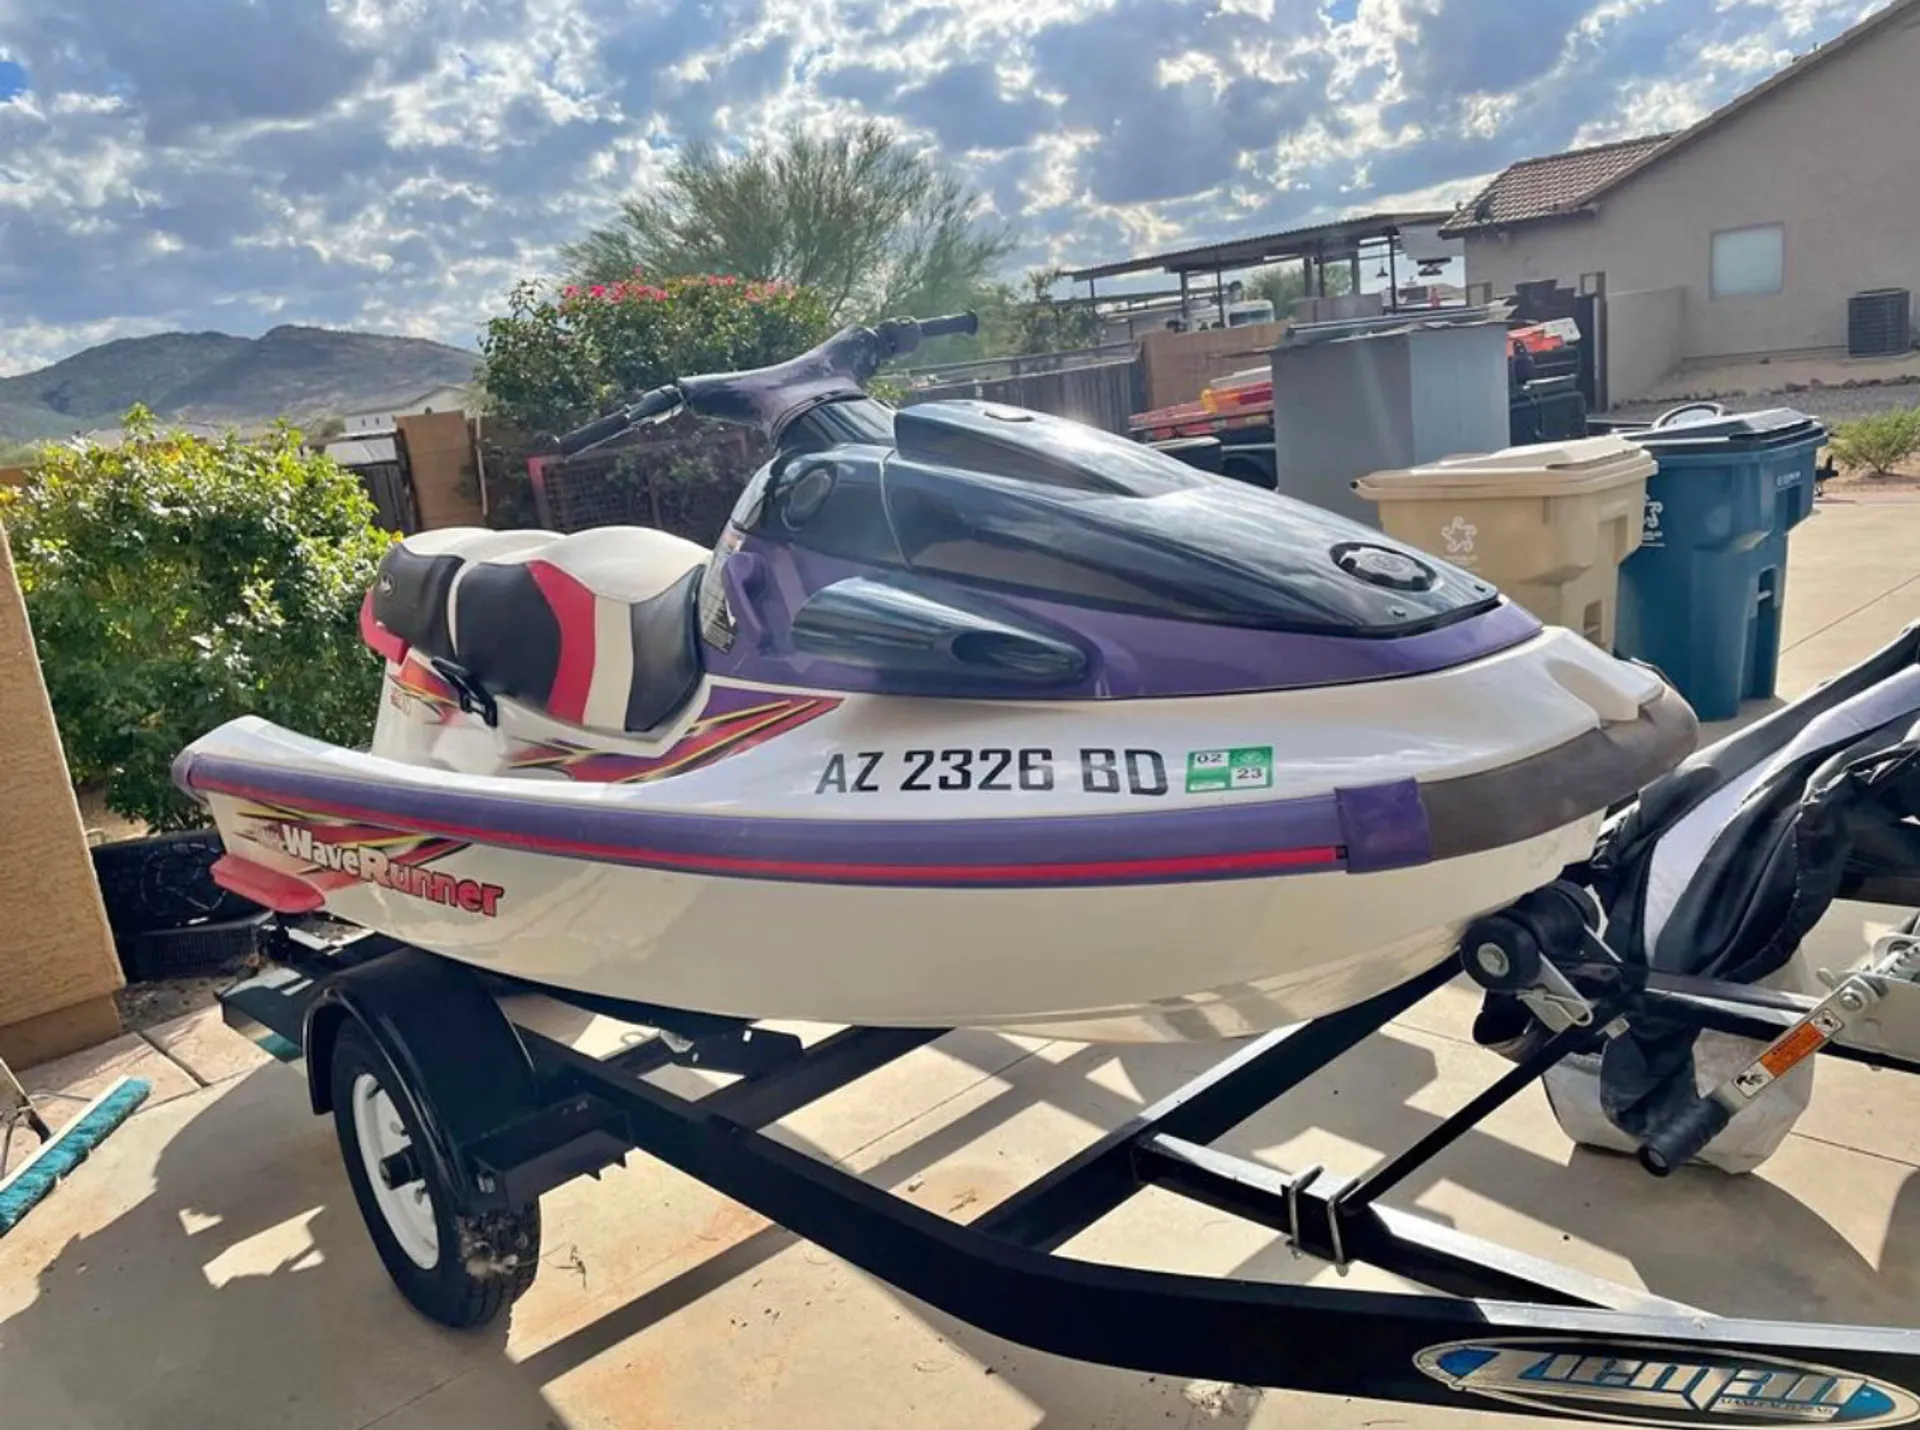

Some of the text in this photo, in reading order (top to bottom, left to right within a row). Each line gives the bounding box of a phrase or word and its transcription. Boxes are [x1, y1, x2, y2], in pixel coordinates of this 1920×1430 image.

[815, 747, 1169, 795] AZ 2326 BD
[1197, 753, 1222, 764] 02
[1236, 767, 1262, 779] 23
[281, 822, 505, 917] WaveRunner
